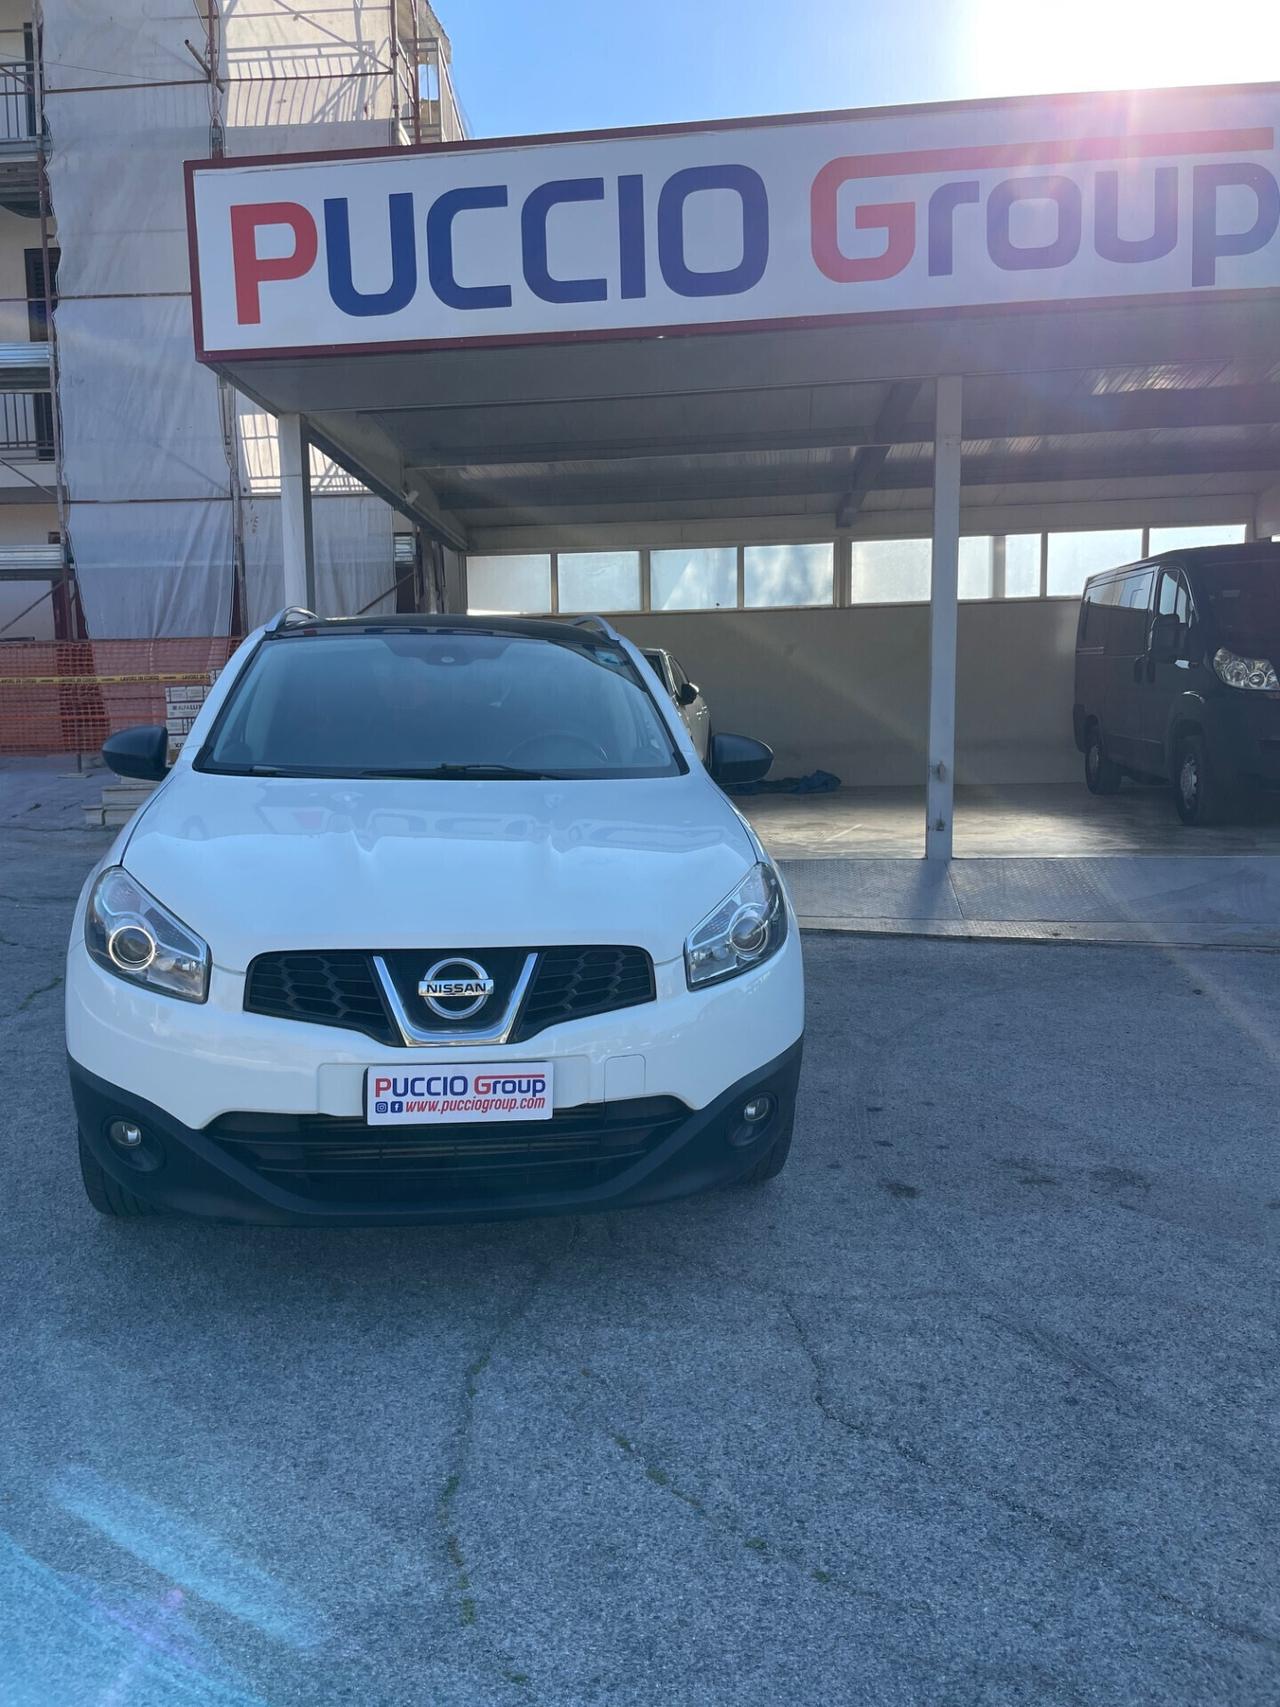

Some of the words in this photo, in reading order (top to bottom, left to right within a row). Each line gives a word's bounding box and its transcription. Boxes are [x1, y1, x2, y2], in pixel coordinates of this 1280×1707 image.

[230, 164, 769, 325] PUCCIO
[810, 127, 1280, 288] Group
[426, 983, 486, 994] NISSAN
[375, 1075, 468, 1098] PUCCIO
[473, 1074, 546, 1097] Group
[405, 1097, 545, 1114] www.pucciogroup.com
